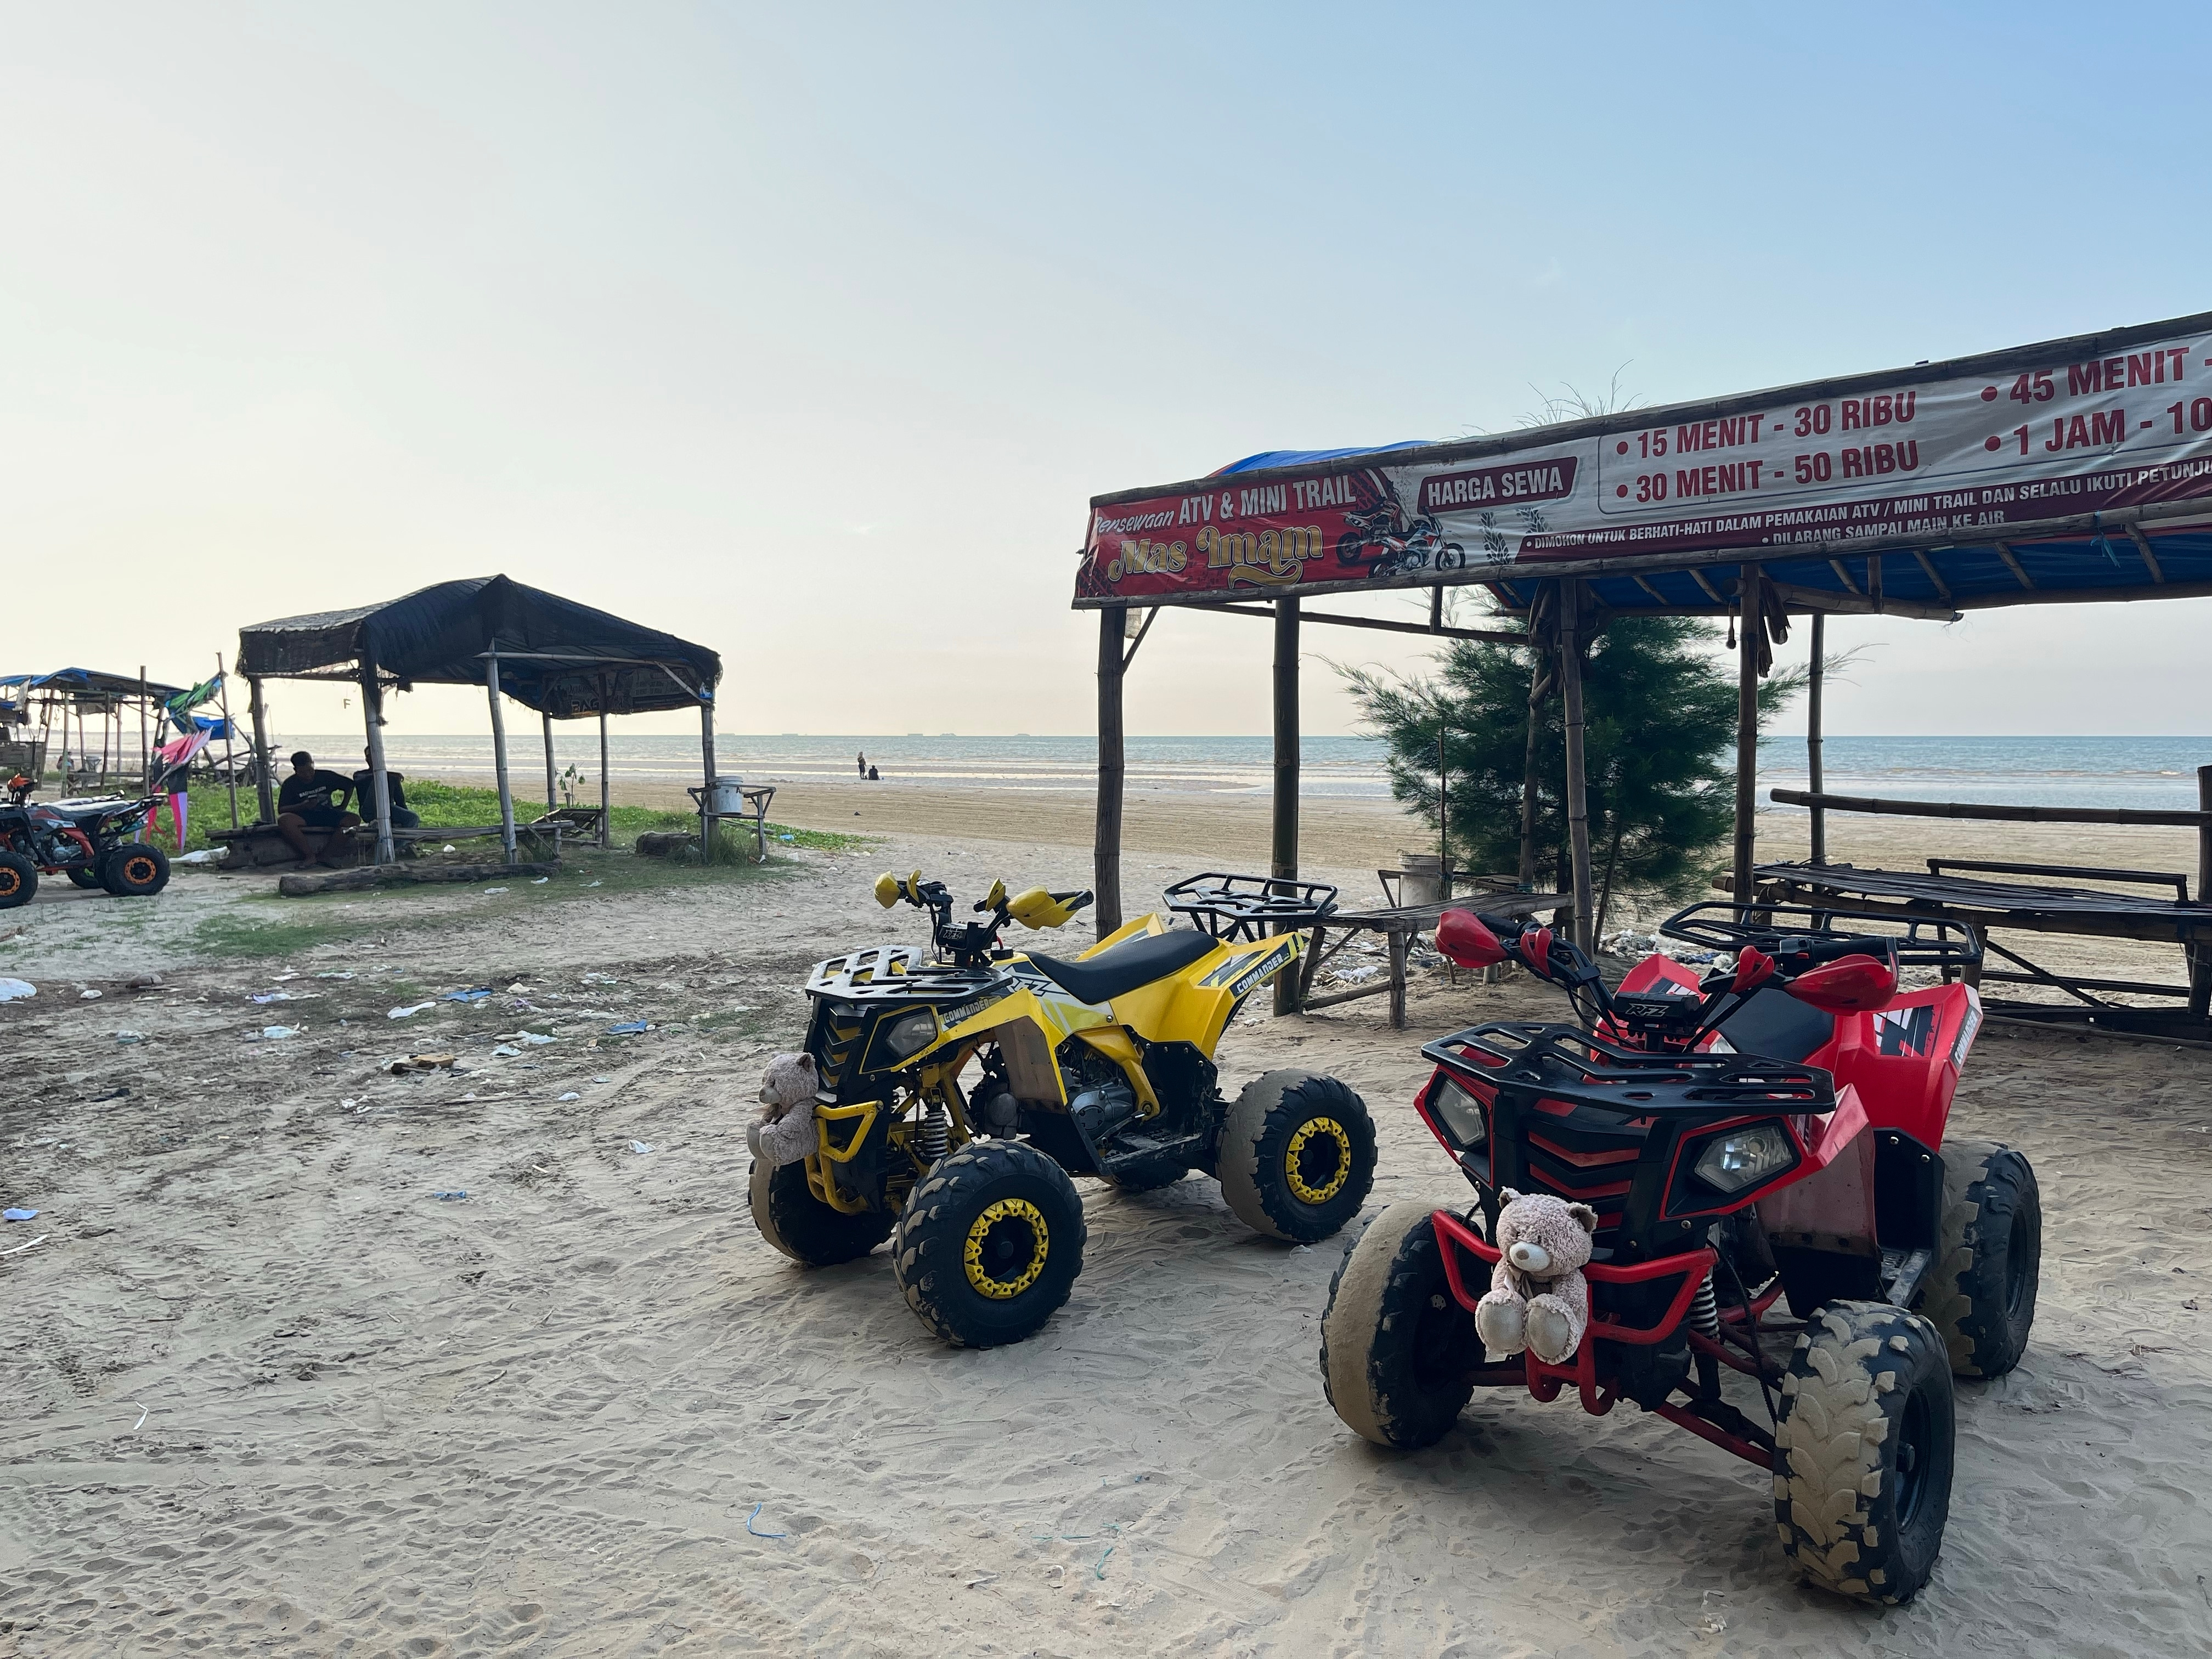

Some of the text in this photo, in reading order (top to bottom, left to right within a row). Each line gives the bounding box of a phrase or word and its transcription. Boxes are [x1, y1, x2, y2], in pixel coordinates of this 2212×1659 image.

[2010, 370, 2055, 405] 45
[2068, 347, 2190, 396] MENIT
[1637, 429, 1667, 459] 15
[1677, 413, 1764, 454] MENIT
[1794, 404, 1831, 437] 30
[1842, 391, 1916, 431] RIBU
[2013, 425, 2029, 455] 1
[2046, 409, 2125, 452] JAM
[2140, 420, 2152, 429] -
[1427, 466, 1563, 507] HARGA SEWA
[1636, 473, 1667, 503] 30
[1677, 460, 1763, 498] MENIT
[1795, 452, 1832, 484] 50
[1843, 441, 1918, 478] RIBU
[1178, 494, 1213, 524] ATV
[1220, 492, 1234, 519] &
[1240, 484, 1286, 516] MINI
[1293, 475, 1356, 510] TRAIL
[1534, 534, 1585, 549] DIMOHON
[1587, 529, 1626, 544] UNTUK
[1629, 521, 1712, 540] BERHATI-HATI
[1716, 516, 1761, 532] DALAM
[1765, 506, 1848, 527] PEMAKAIAN
[1852, 503, 1880, 518] ATV
[1883, 502, 1891, 517] /
[1894, 497, 1928, 515] MINI
[1933, 492, 1977, 510] TRAIL
[1982, 487, 2015, 504] DAN
[2019, 479, 2081, 500] SELALU
[2086, 472, 2132, 492] IKUTI
[1773, 510, 2005, 545] DILARANG SAMPAI MAIN KE AIR
[1108, 526, 1324, 588] Mas Imam
[1237, 953, 1284, 994] COMMANDER
[944, 998, 990, 1023] COMMANDER
